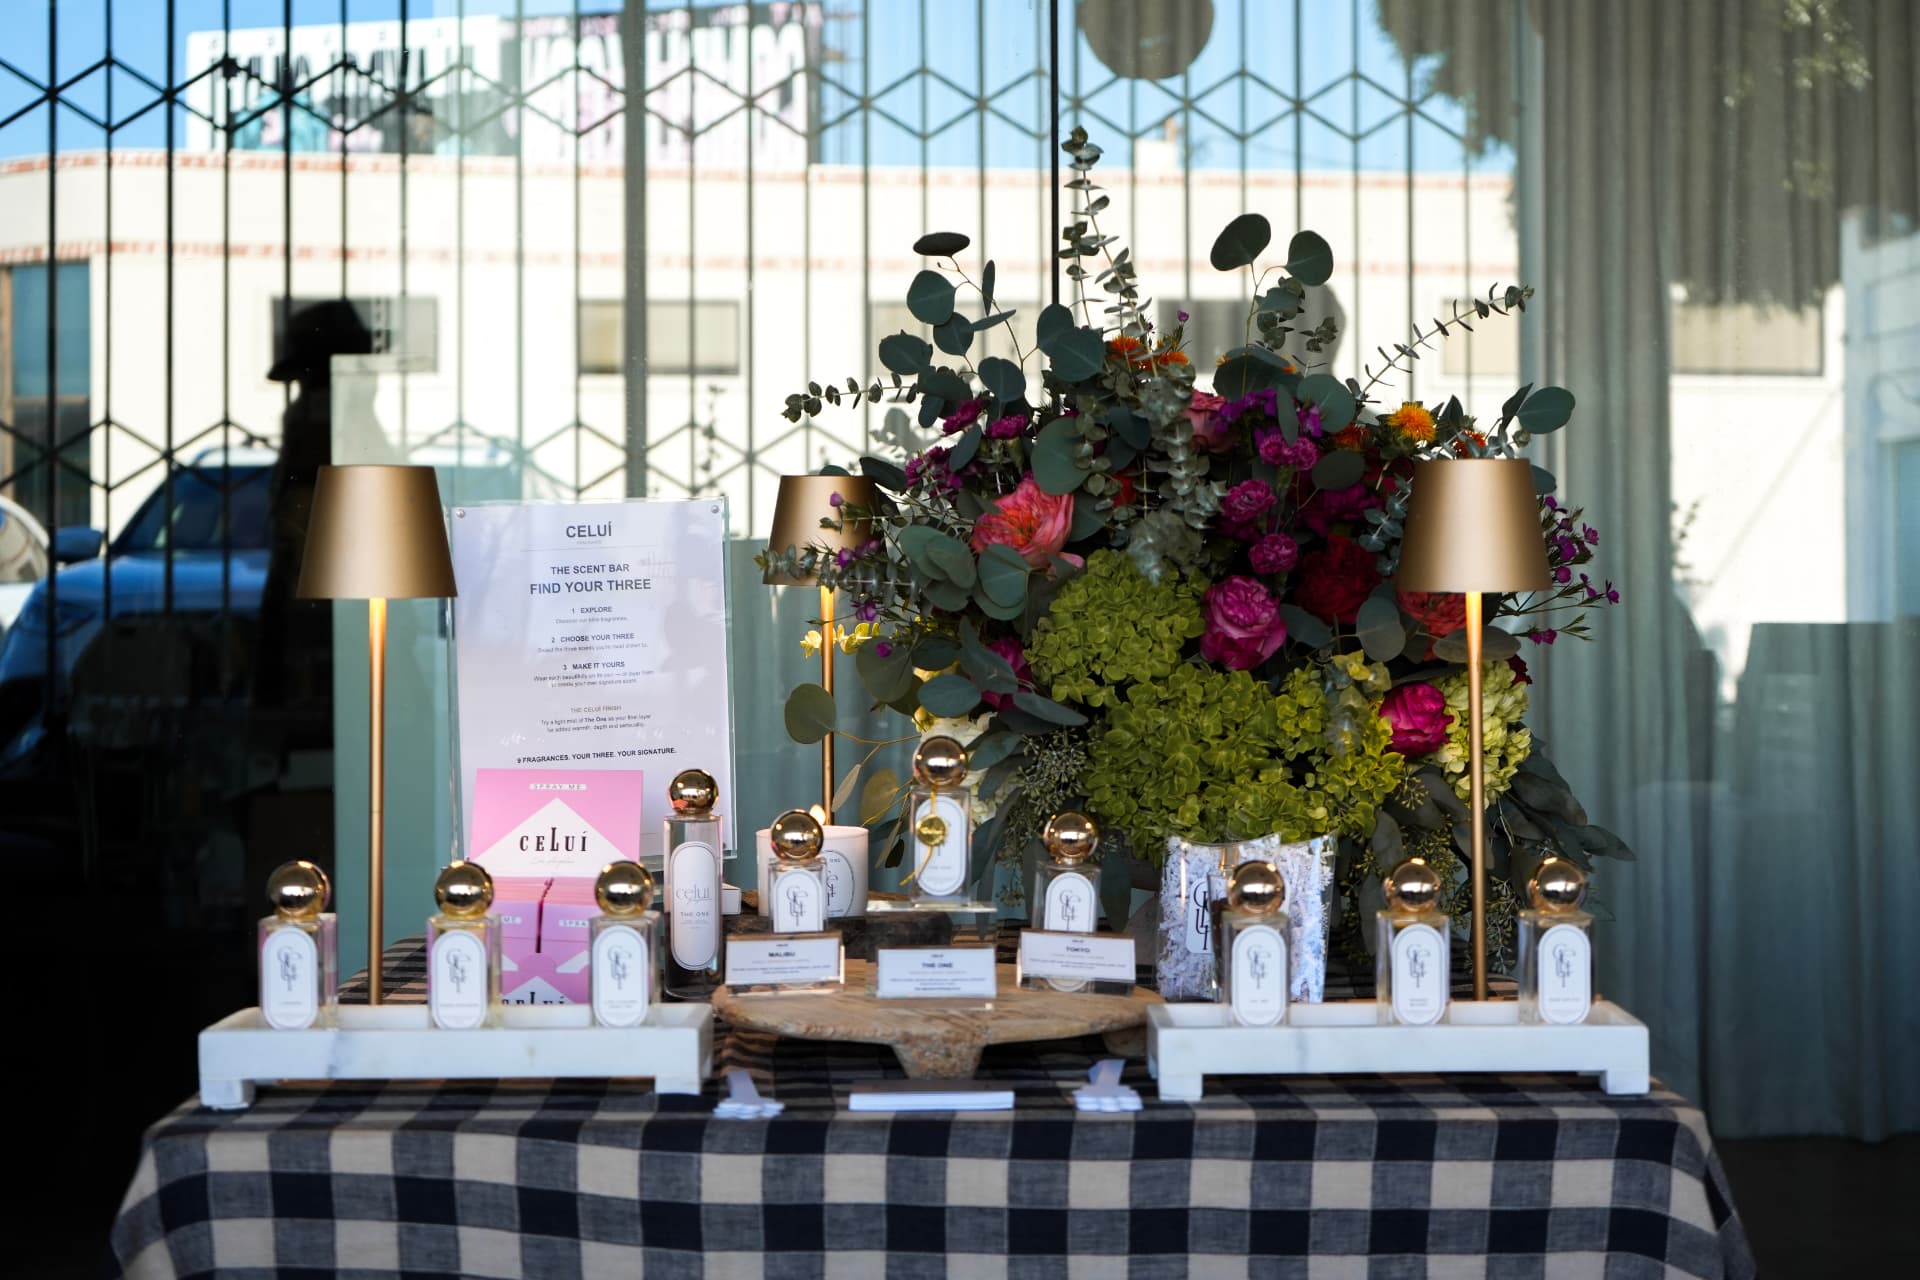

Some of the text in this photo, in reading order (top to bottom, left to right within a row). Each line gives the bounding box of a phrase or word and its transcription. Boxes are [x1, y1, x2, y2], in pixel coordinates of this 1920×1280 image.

[566, 521, 612, 538] CELUÍ
[551, 563, 630, 575] THE SCENT BAR
[530, 579, 651, 595] FIND YOUR THREE
[580, 606, 612, 614] EXPLORE
[560, 635, 589, 643] CHOOSE
[523, 753, 570, 763] FRAGRANCES.
[572, 752, 591, 760] YOUR
[593, 751, 616, 759] THREE.
[637, 747, 677, 756] SIGNATURE.
